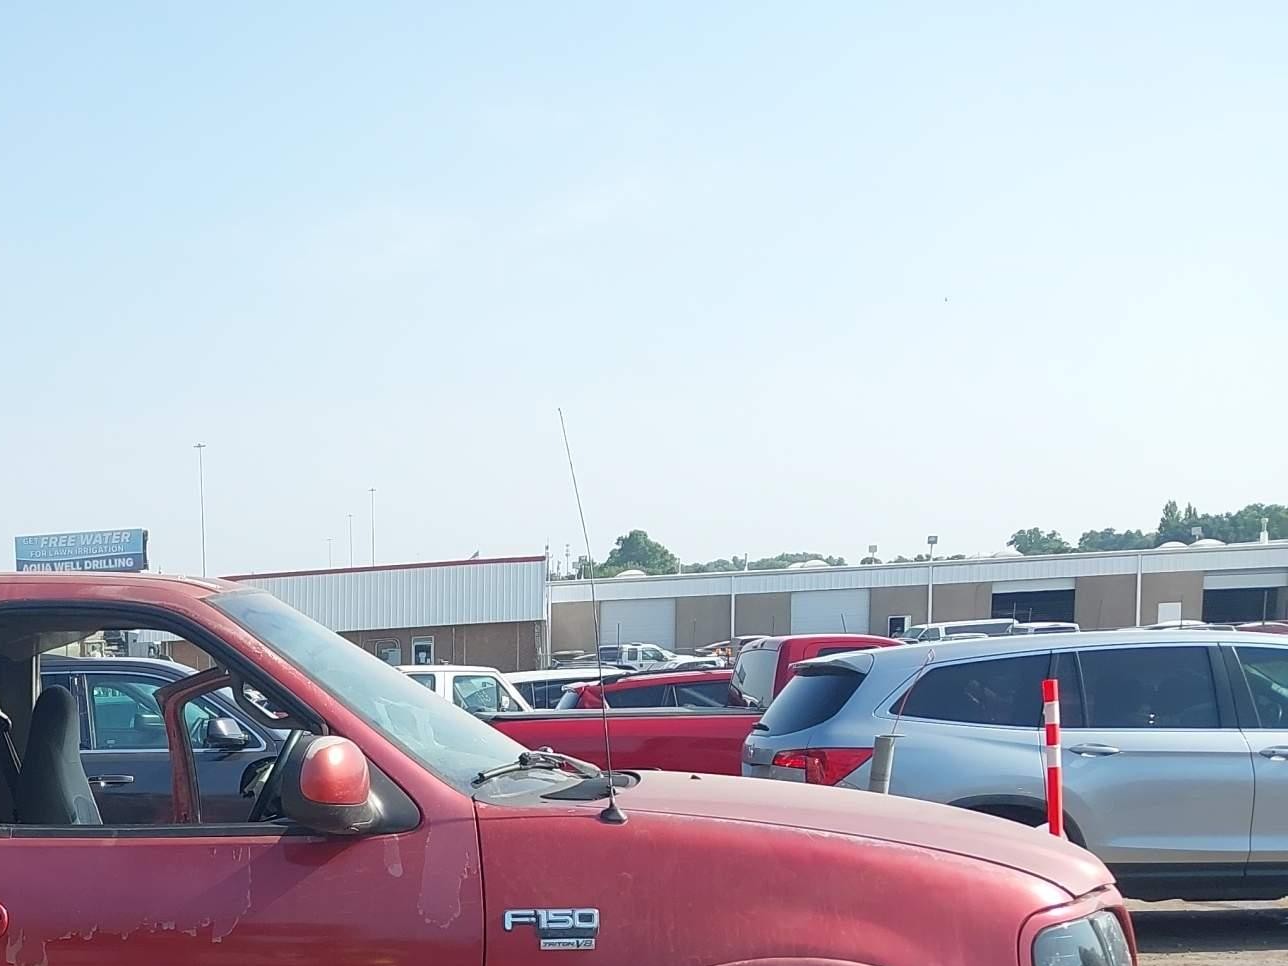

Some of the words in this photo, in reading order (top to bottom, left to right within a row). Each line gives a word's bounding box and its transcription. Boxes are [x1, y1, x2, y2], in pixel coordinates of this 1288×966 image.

[40, 535, 76, 548] FREE
[80, 531, 131, 546] WATER
[30, 550, 47, 558] FOR
[49, 548, 73, 557] LAWN
[75, 544, 124, 555] IRRIGATION
[54, 560, 82, 571] WELL
[84, 557, 133, 570] DRILLING
[575, 940, 593, 948] V8
